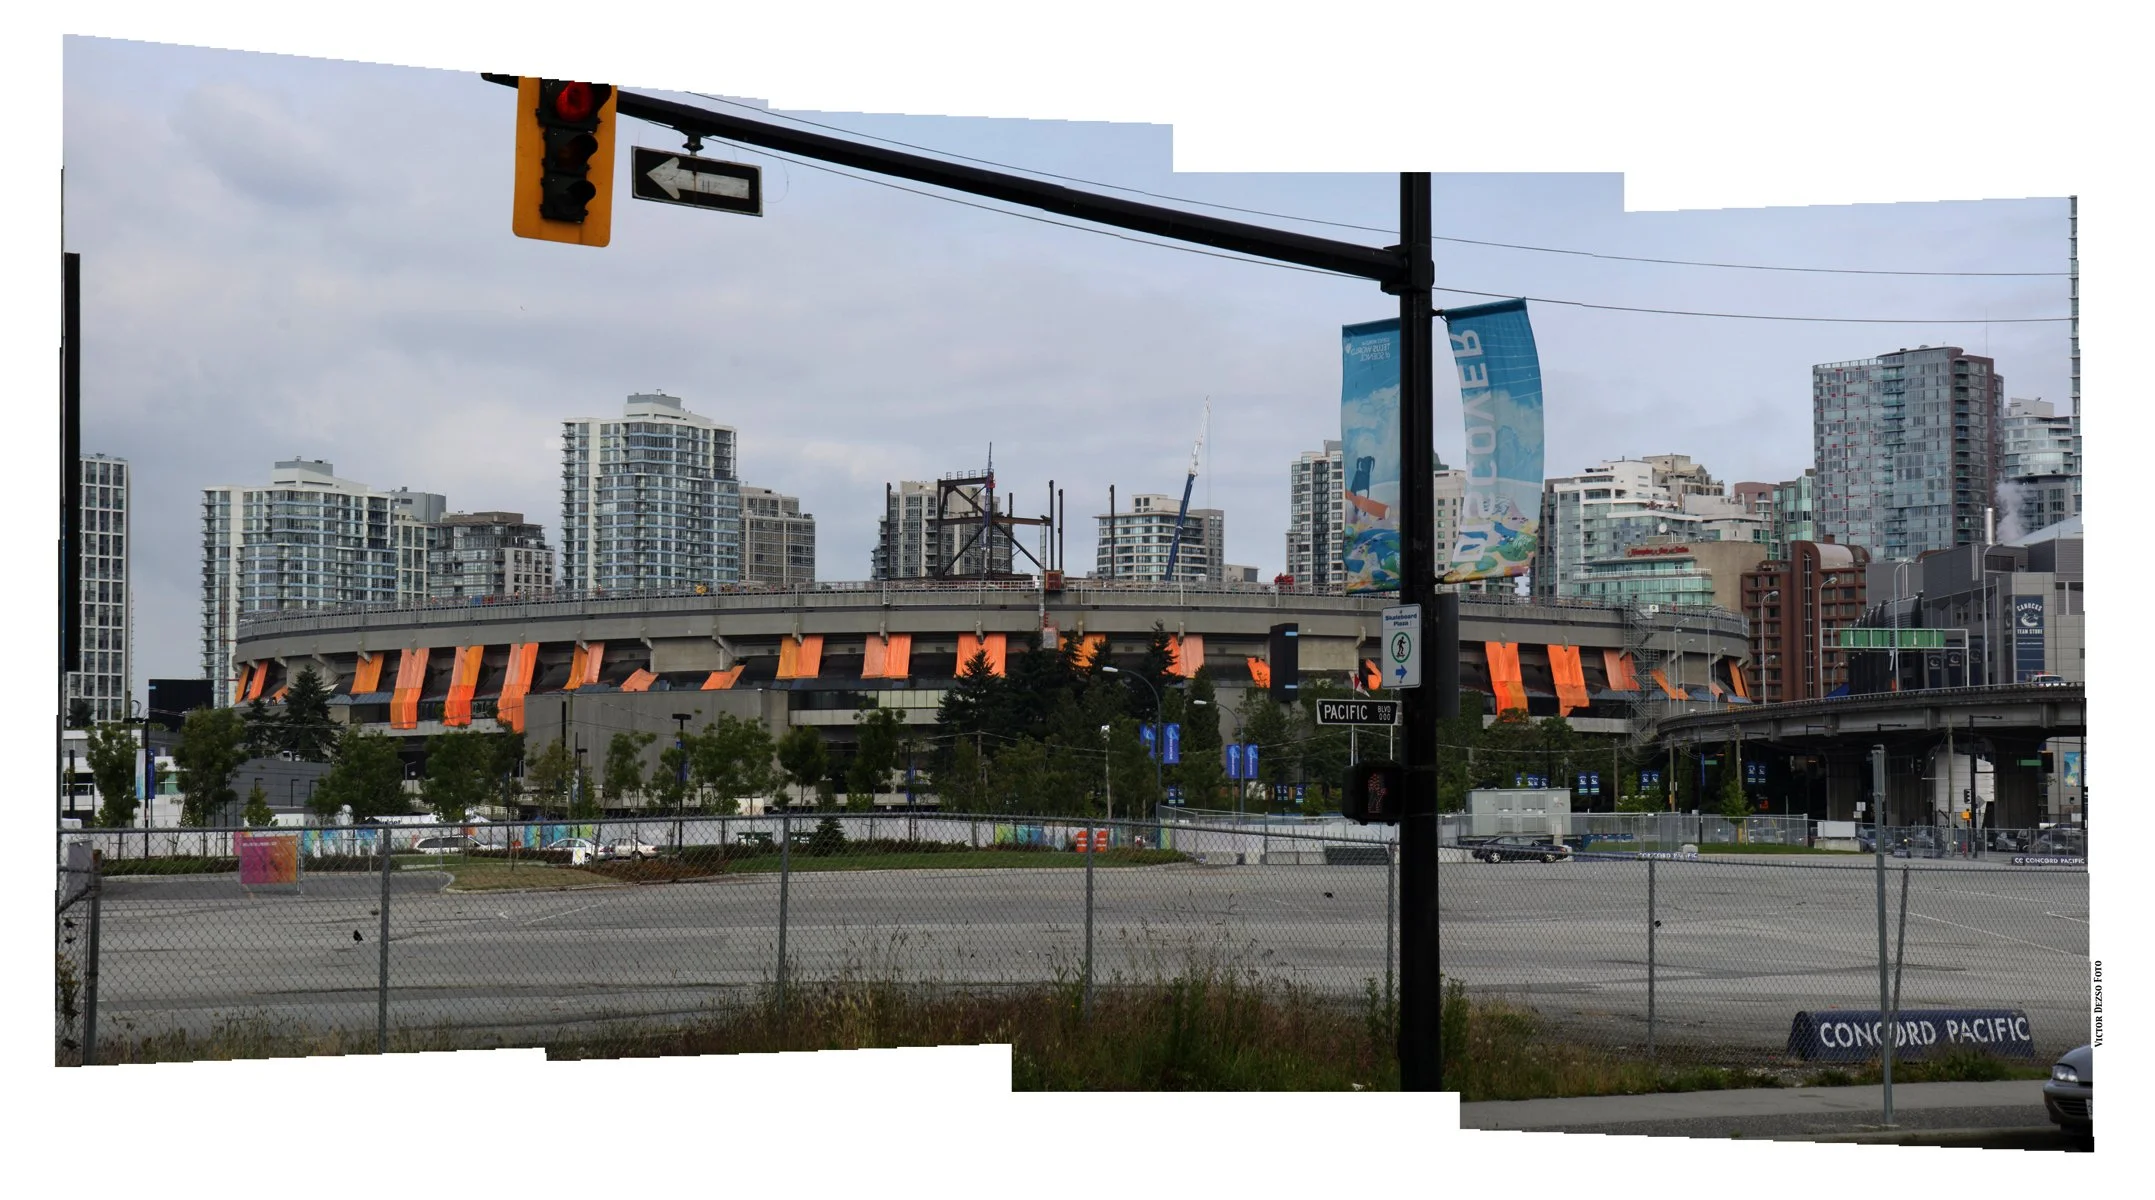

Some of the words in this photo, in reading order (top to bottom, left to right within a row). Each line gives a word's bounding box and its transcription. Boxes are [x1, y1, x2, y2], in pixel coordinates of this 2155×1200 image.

[2016, 602, 2043, 612] CANUCKS
[1385, 613, 1418, 621] Skateboard
[1324, 704, 1368, 720] PACIFIC
[1378, 705, 1391, 713] BLVD
[1946, 1017, 2030, 1044] PACIFIC
